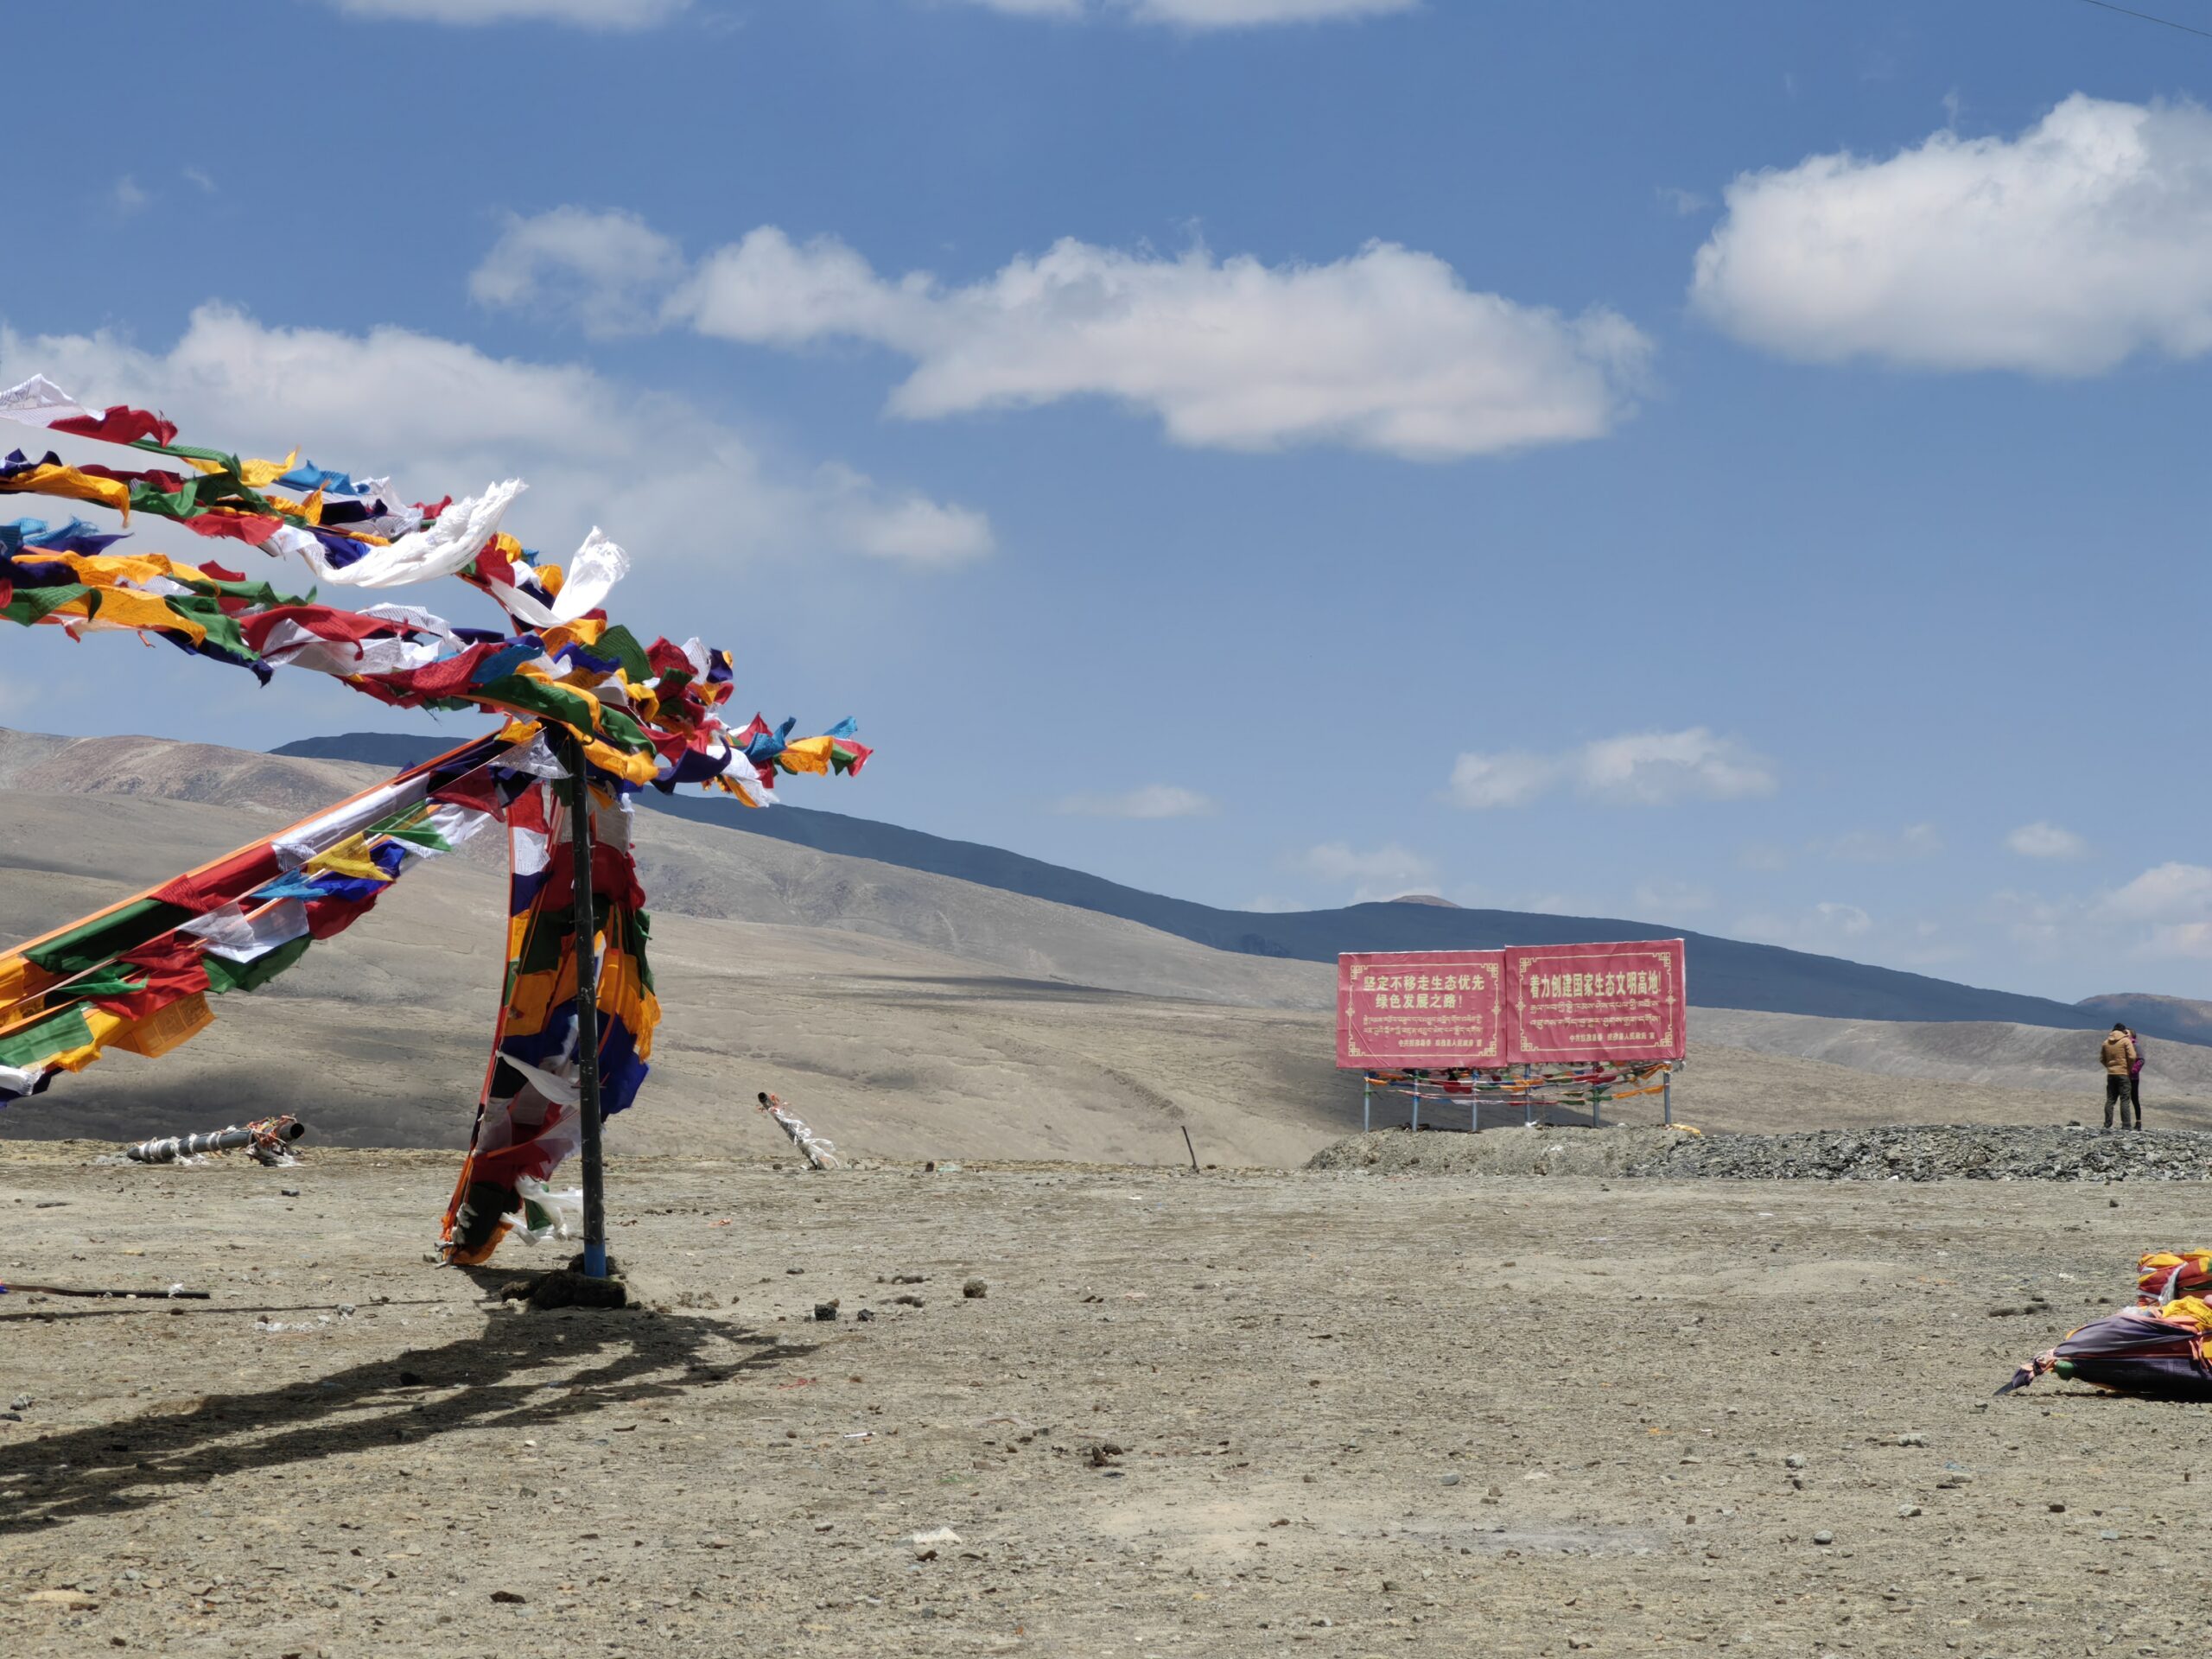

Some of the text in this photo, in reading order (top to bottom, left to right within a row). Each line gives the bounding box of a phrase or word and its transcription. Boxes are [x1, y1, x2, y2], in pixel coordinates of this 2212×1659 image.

[1363, 974, 1484, 991] 坚定不移走生态优先
